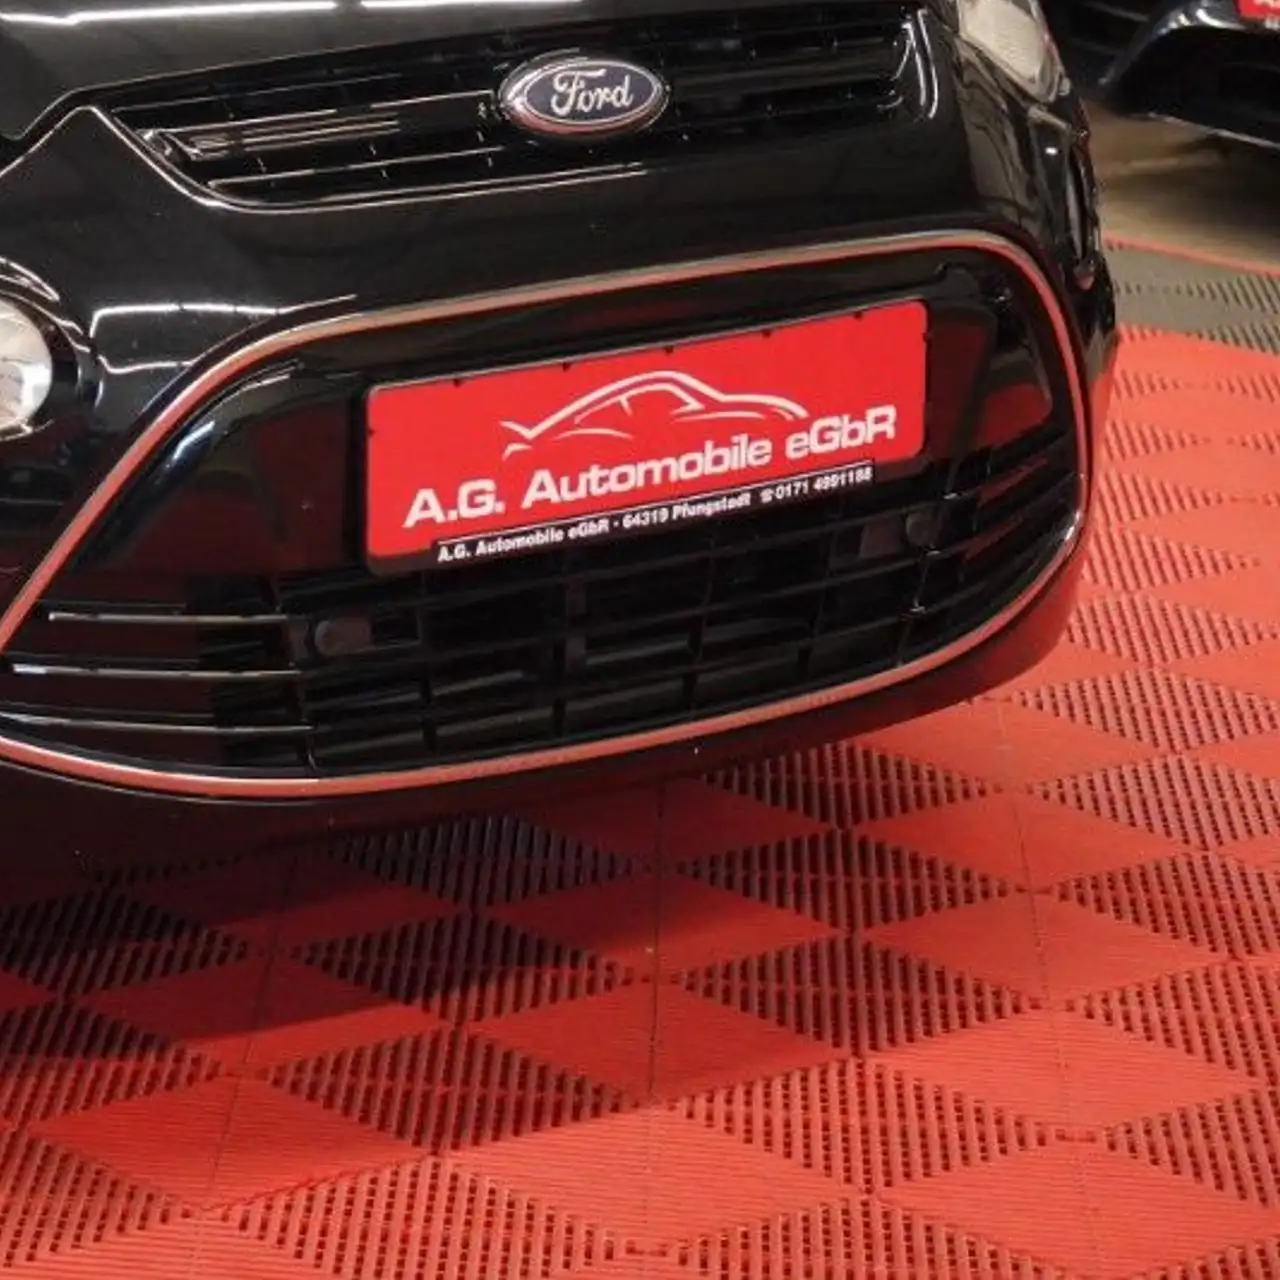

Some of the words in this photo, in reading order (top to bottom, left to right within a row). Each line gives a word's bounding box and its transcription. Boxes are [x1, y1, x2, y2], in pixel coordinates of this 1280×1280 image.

[550, 69, 634, 116] Ford
[402, 478, 506, 528] A.G.
[521, 434, 772, 509] Automobile
[786, 405, 896, 459] eGbR
[438, 546, 471, 563] A.G.
[476, 528, 564, 555] Automobile
[568, 520, 609, 538] eGbR
[621, 509, 669, 528] 64319
[672, 493, 752, 521] Pfungstadt
[776, 485, 809, 501] 0171
